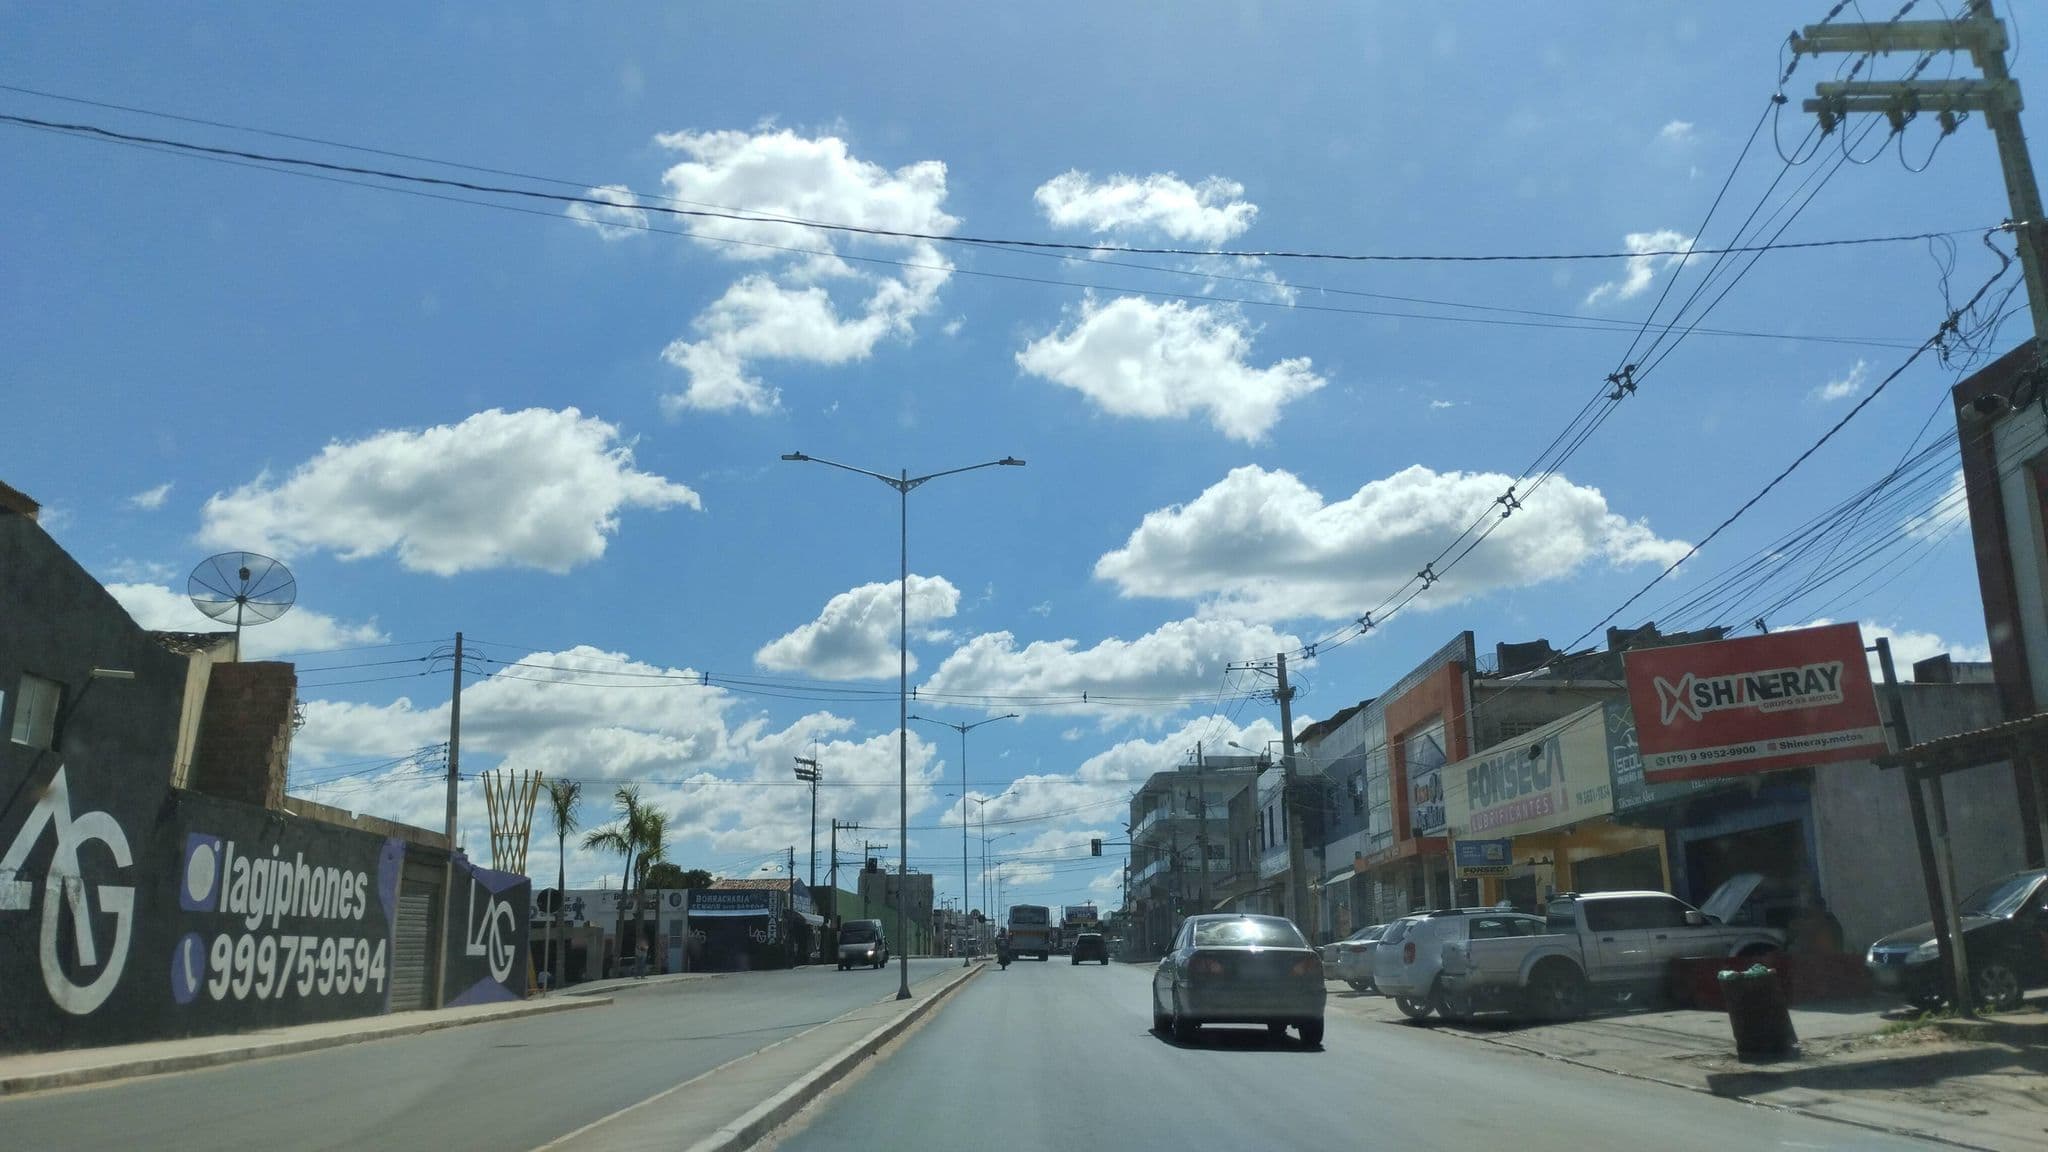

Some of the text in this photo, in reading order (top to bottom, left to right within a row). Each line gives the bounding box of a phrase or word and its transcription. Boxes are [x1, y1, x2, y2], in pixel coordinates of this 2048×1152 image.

[1693, 665, 1841, 709] SHINERAY
[1467, 734, 1565, 810] FONSECA
[1667, 753, 1688, 764] (79)
[1690, 751, 1698, 761] 9
[1471, 796, 1550, 832] LUBRIFICANTES
[219, 840, 369, 931] lagiphones
[466, 878, 516, 984] LAG
